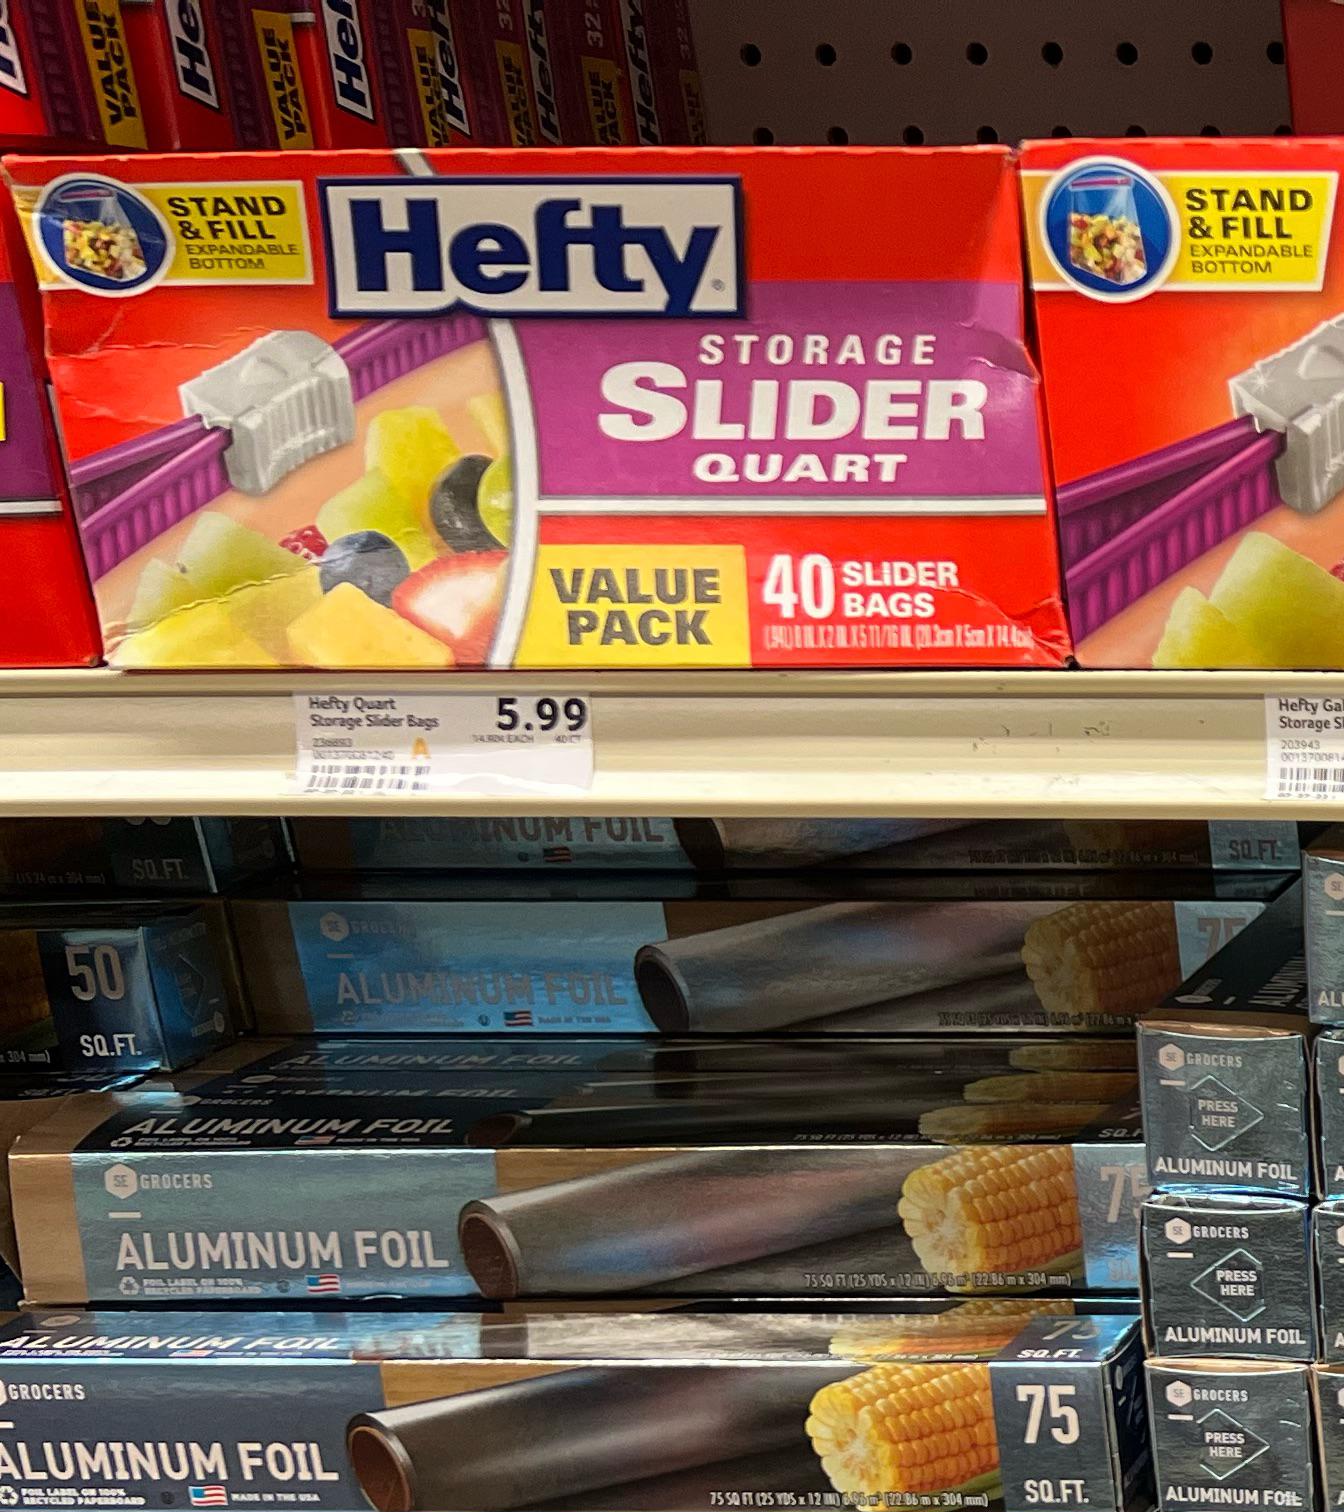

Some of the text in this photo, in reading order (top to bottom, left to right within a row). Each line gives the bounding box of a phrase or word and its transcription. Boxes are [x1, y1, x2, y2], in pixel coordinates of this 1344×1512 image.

[1185, 188, 1313, 213] STAND
[1188, 216, 1292, 240] & FILL
[348, 198, 719, 314] Hefty
[1189, 244, 1312, 259] EXPANDABLE
[1191, 260, 1272, 275] BOTTOM
[698, 334, 937, 367] STORAGE
[598, 361, 988, 442] SLIDER
[693, 453, 907, 483] QUART
[762, 554, 836, 619] 40
[496, 697, 588, 732] 5.99
[1278, 699, 1319, 714] Hefty
[1279, 717, 1331, 732] Storage
[68, 944, 126, 1004] 50
[80, 1034, 143, 1060] SQ.FT.
